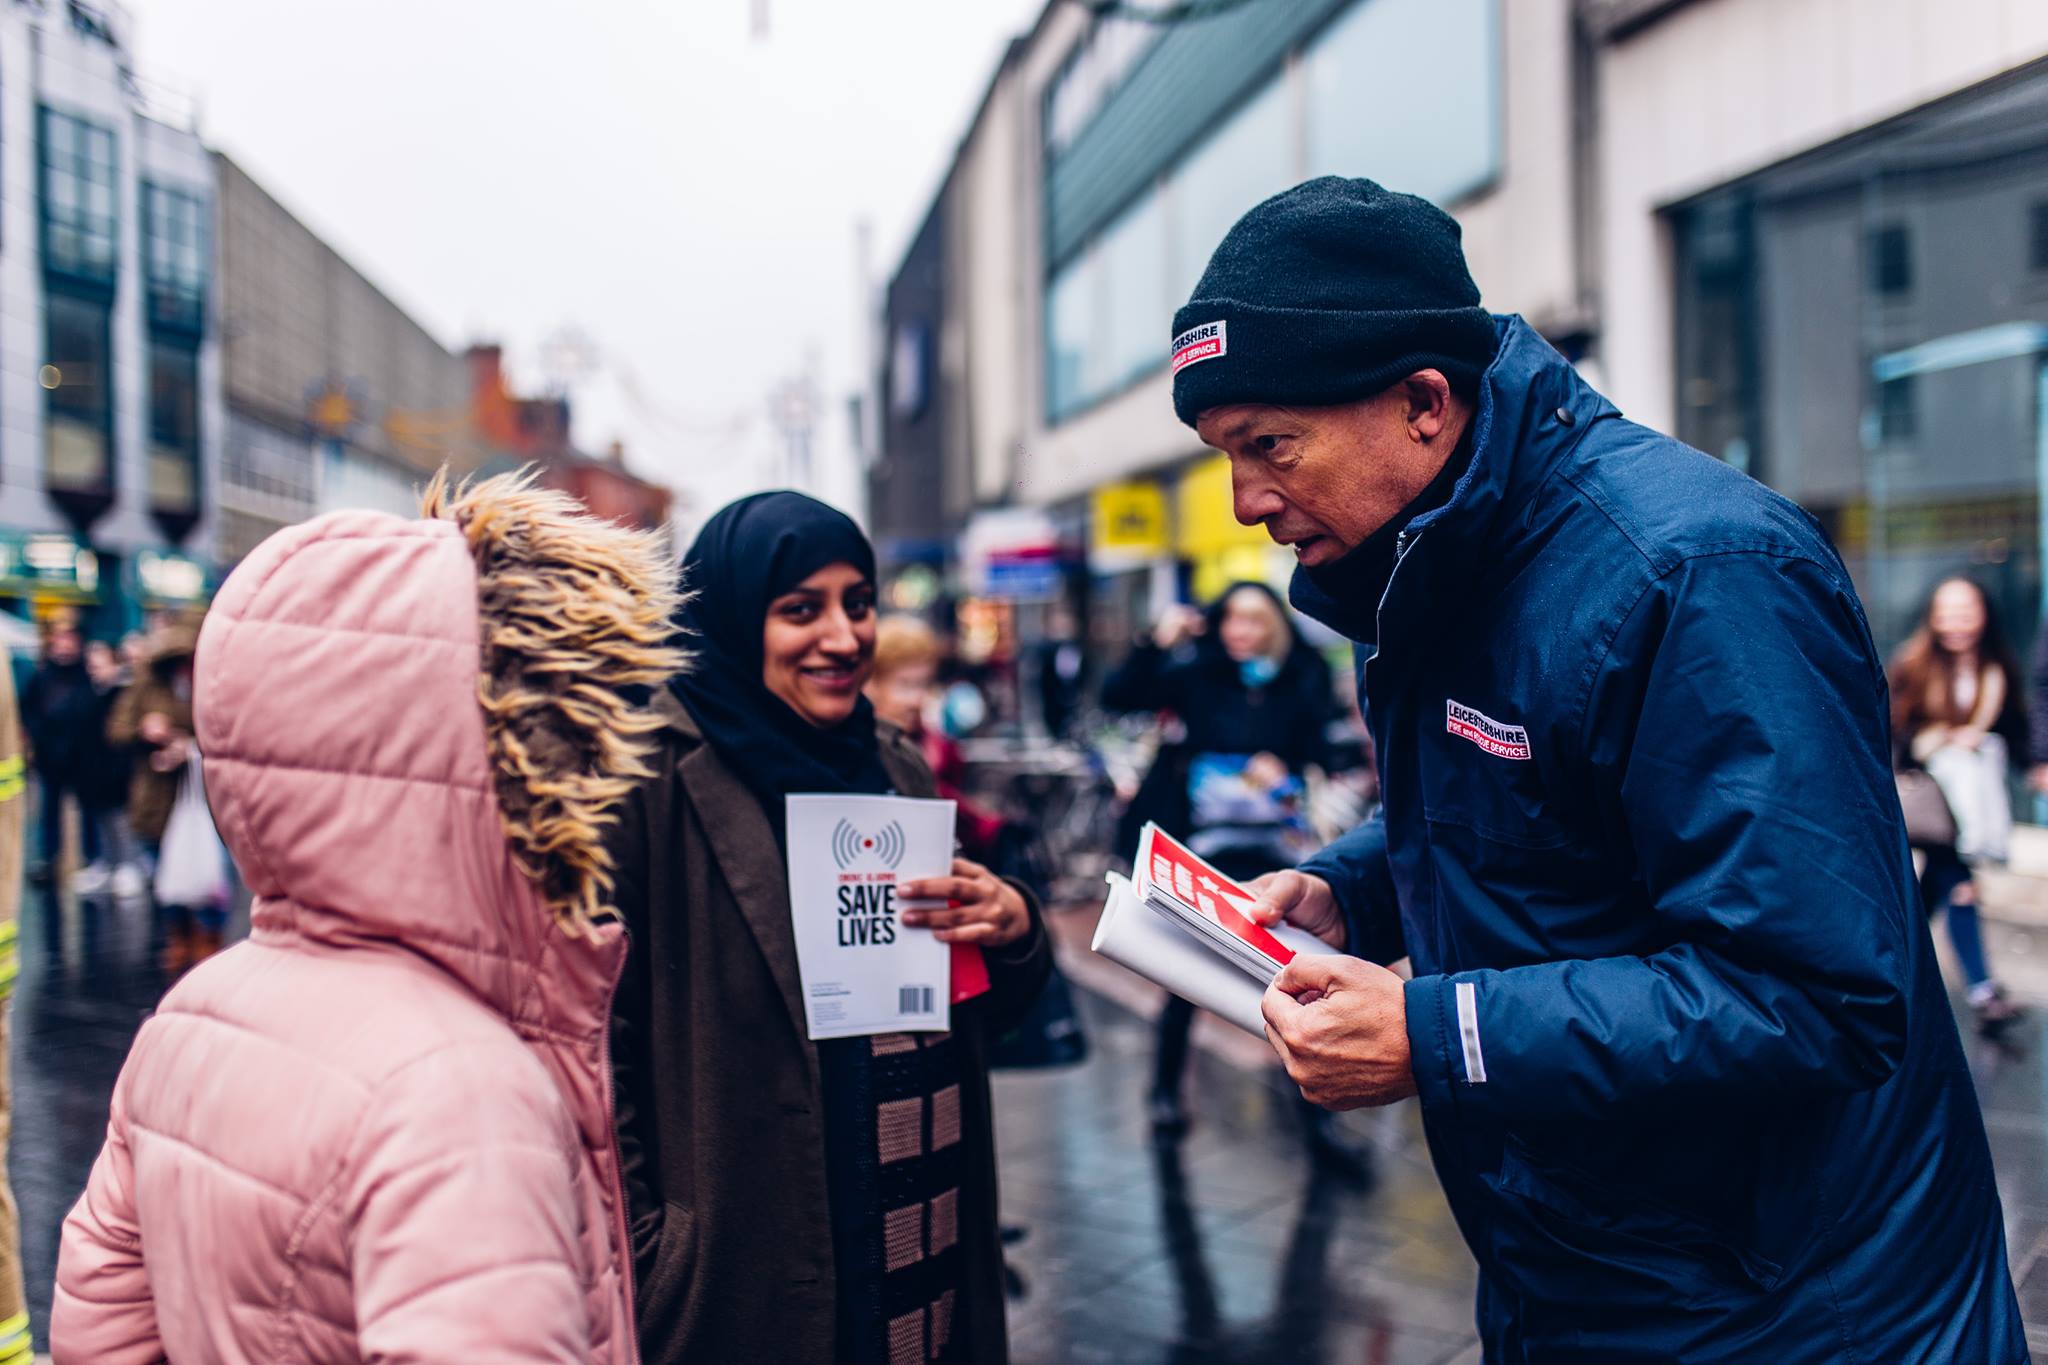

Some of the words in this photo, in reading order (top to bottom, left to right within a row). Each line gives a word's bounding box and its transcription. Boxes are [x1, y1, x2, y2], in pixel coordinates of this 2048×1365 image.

[1187, 343, 1216, 359] SERVICE
[1448, 704, 1526, 743] LEICESTERSHIRE
[1490, 742, 1527, 756] SERVICE
[838, 884, 896, 916] SAVE
[838, 916, 896, 947] LIVES
